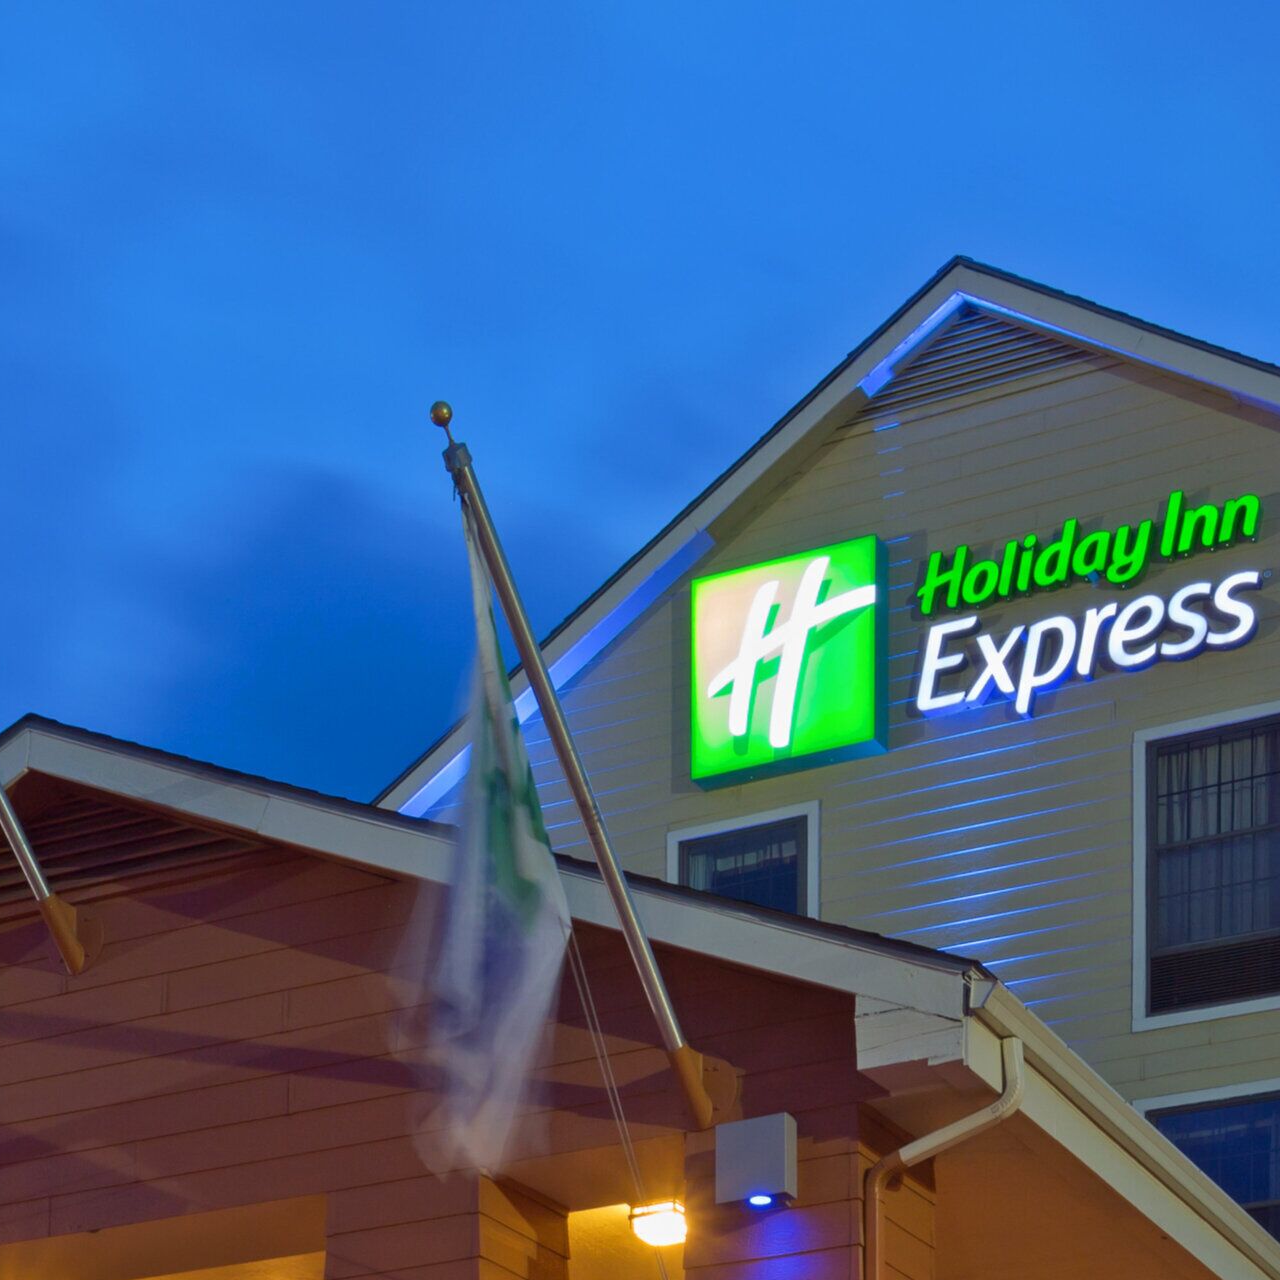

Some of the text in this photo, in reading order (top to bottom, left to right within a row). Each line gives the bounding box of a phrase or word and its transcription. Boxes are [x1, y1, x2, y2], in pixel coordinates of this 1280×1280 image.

[917, 490, 1261, 615] Holiday Inn
[916, 570, 1260, 715] Express
